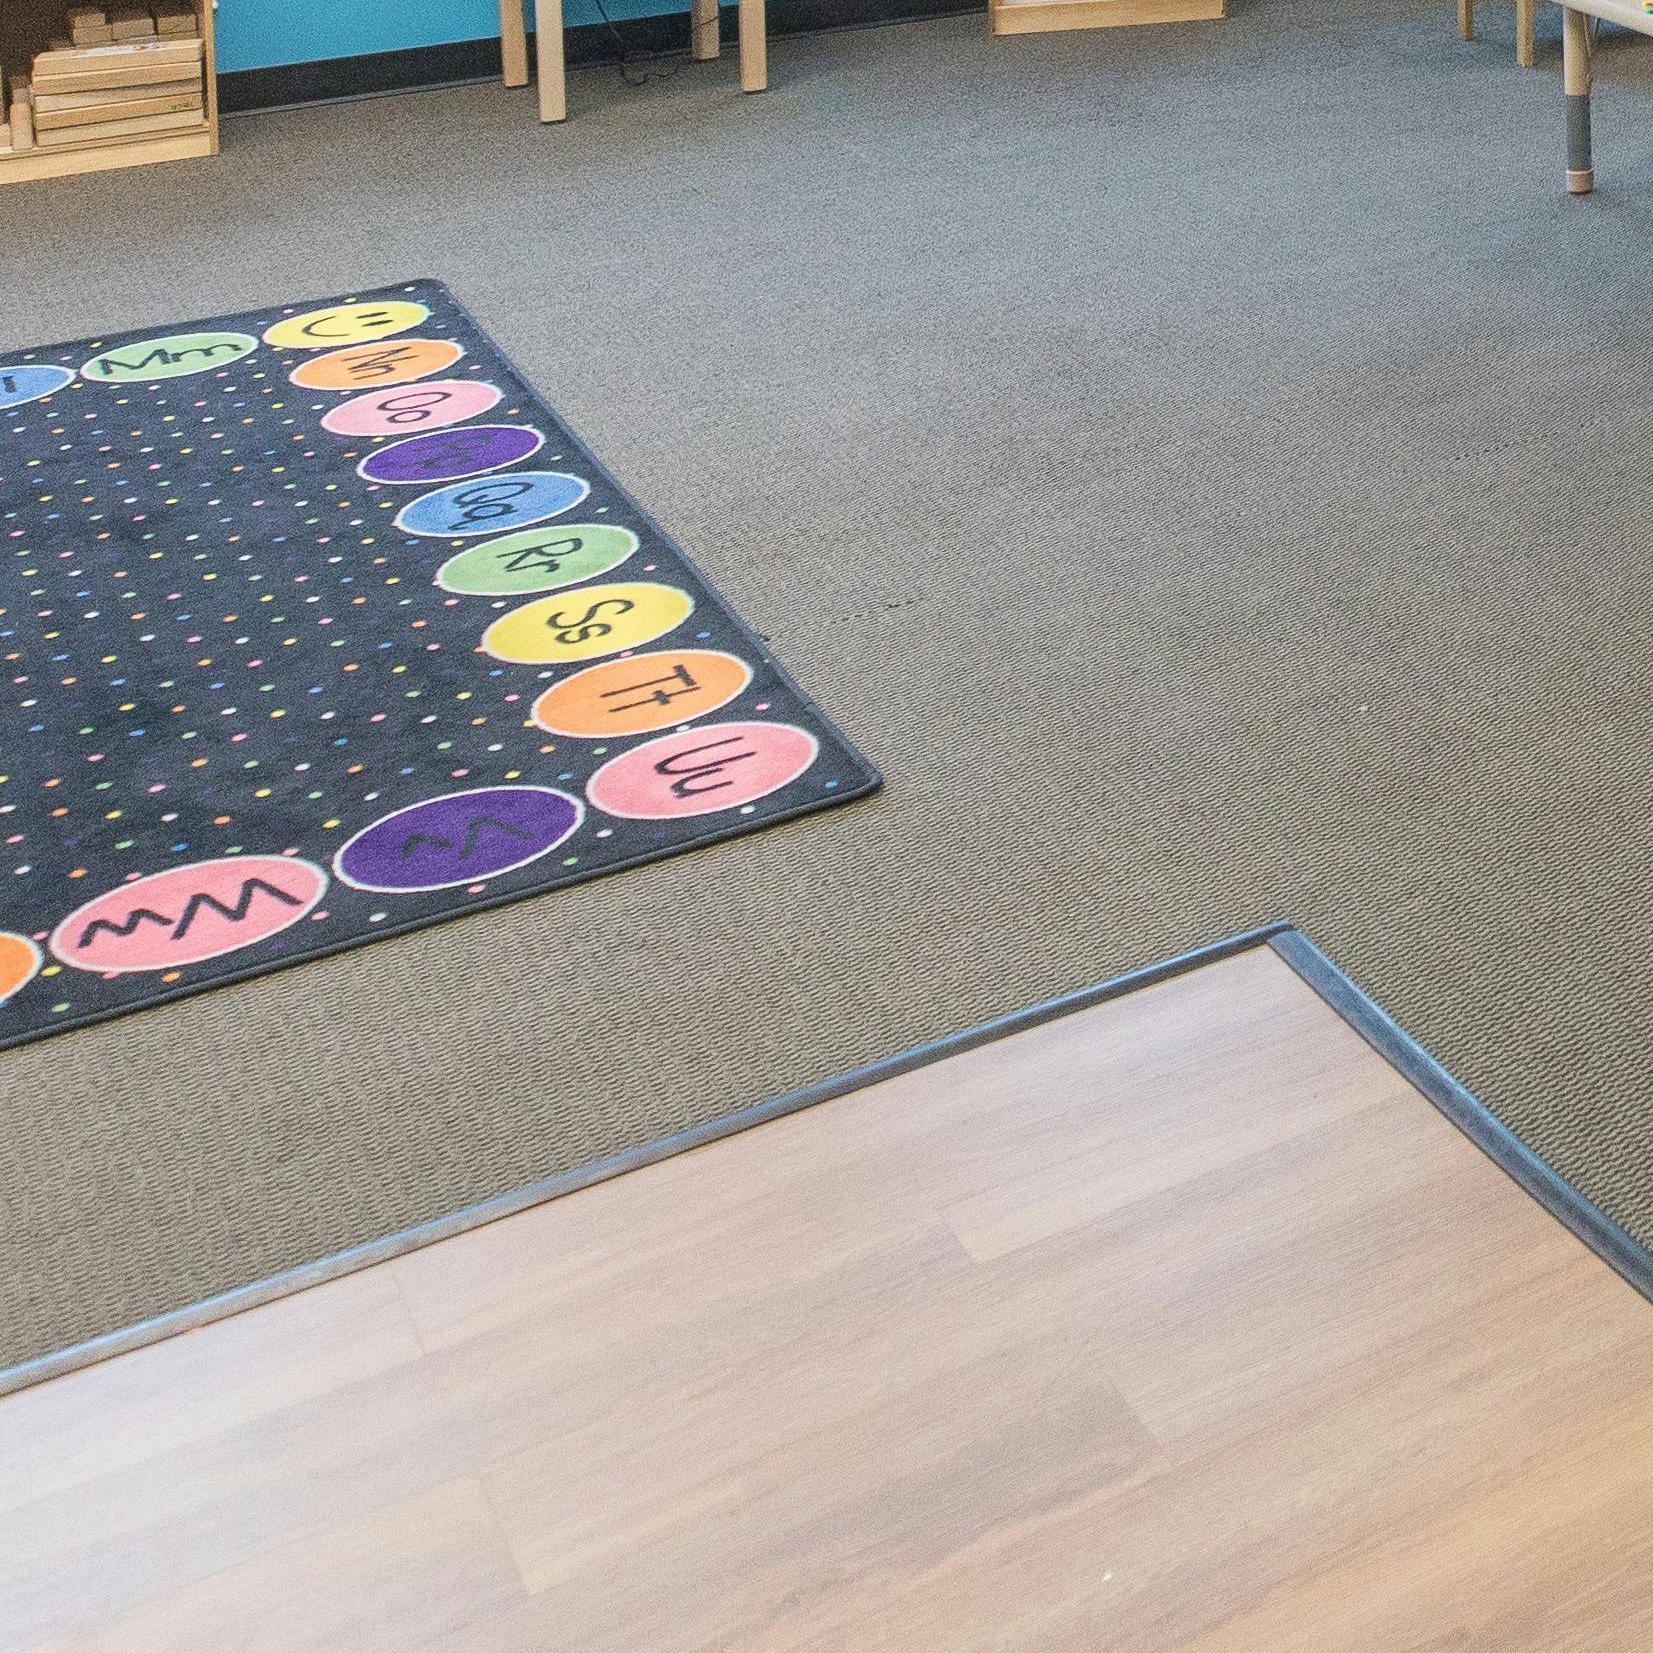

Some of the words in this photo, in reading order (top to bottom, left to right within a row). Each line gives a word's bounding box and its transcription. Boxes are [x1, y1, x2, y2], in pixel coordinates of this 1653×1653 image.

[97, 342, 244, 376] Mm
[342, 346, 419, 381] Nn
[376, 391, 453, 424] Oo
[447, 481, 535, 532] Qq
[496, 536, 584, 574] Rr
[545, 598, 635, 645] Ss
[599, 663, 702, 714] Tt
[654, 735, 758, 800] Uu
